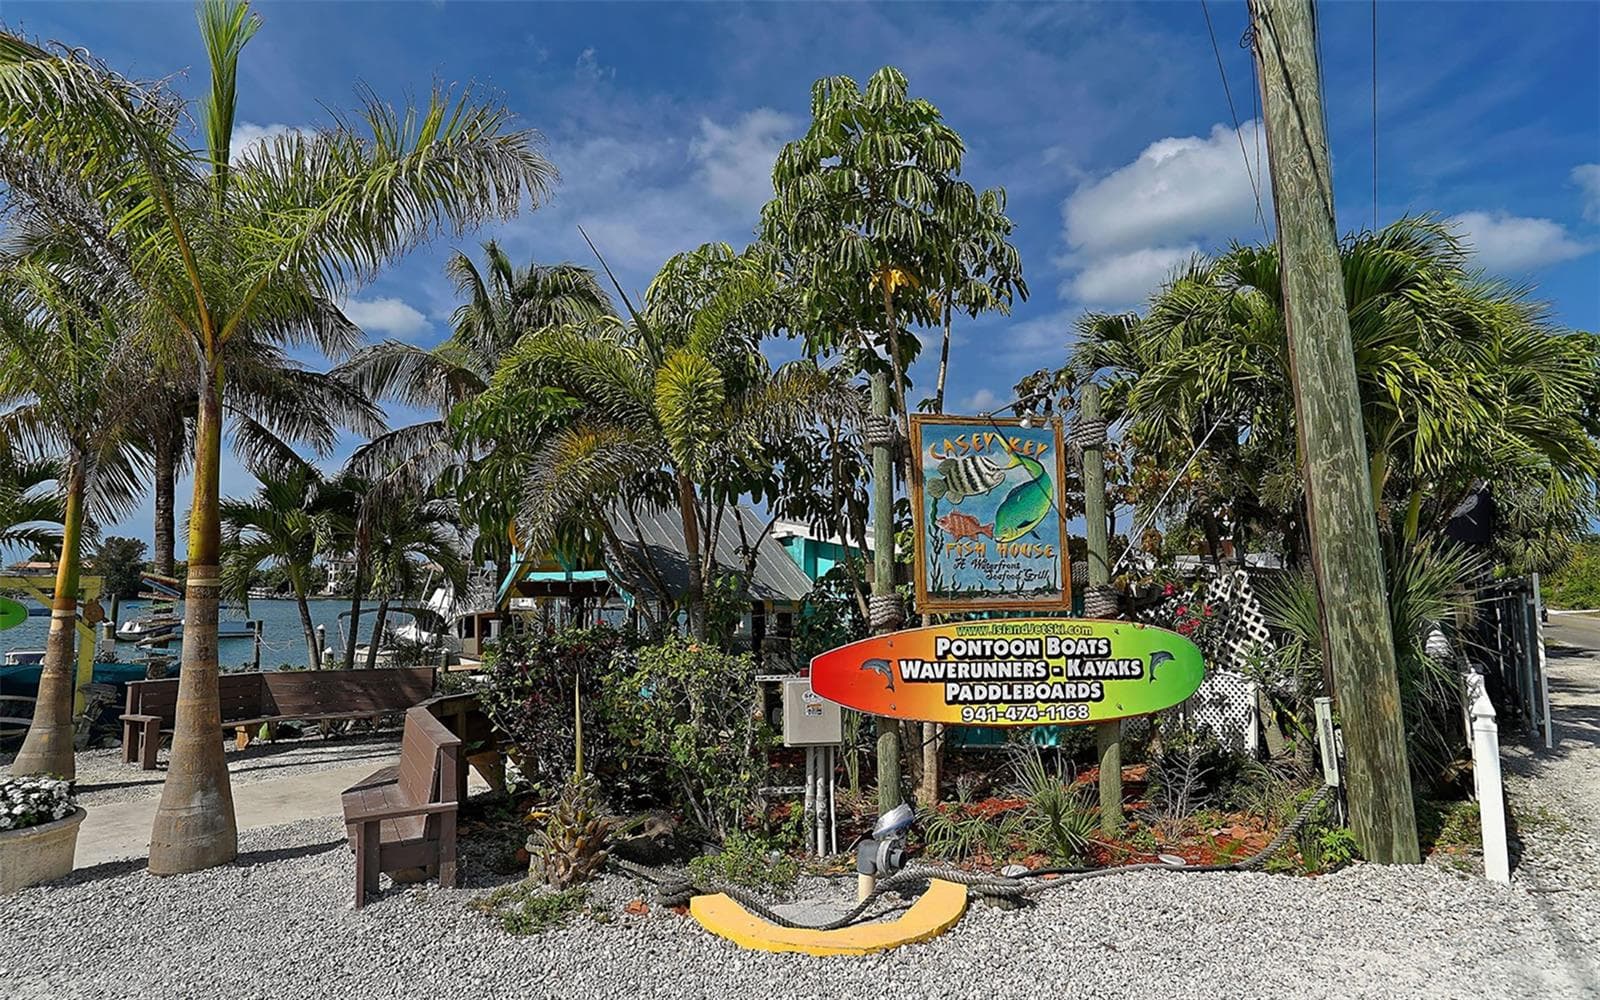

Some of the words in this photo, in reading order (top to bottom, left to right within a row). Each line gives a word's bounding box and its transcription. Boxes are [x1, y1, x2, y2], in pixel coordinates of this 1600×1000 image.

[928, 432, 995, 460] CASEY
[1008, 436, 1049, 461] KEY
[946, 543, 986, 559] FISH
[996, 543, 1056, 559] HOUSE
[953, 558, 967, 570] A
[971, 559, 1021, 574] Waterfront
[985, 568, 1024, 583] Seafood
[1022, 568, 1050, 582] Grill
[937, 638, 1040, 657] PONTOON
[1046, 637, 1109, 656] BOATS
[900, 660, 1047, 679] WAVERUNNERS
[1067, 660, 1141, 677] KAYAKS
[946, 682, 1101, 701] PADDLEBOARDS
[962, 705, 1089, 722] 941-474-1168
